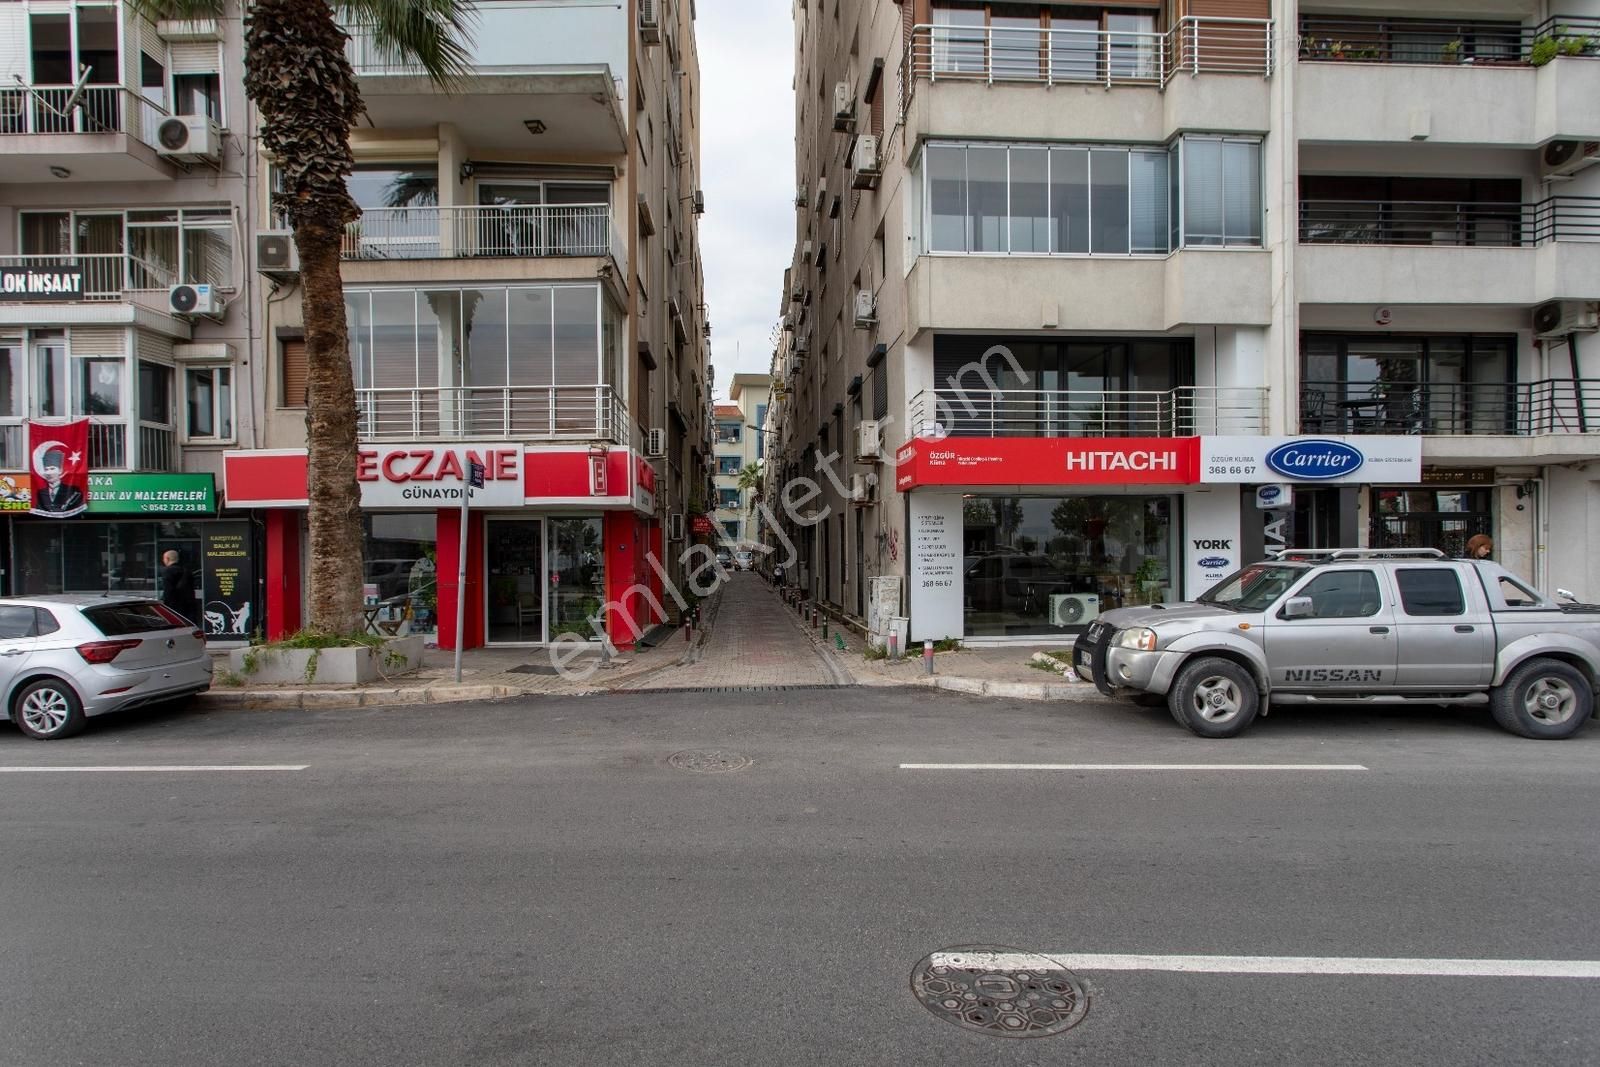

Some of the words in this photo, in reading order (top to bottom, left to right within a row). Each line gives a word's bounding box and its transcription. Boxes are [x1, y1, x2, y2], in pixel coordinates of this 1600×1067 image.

[27, 270, 81, 295] İNŞAAT
[929, 450, 956, 460] ÖZGÜR
[1067, 451, 1177, 471] HITACHI
[1283, 450, 1351, 467] Carrier
[357, 449, 518, 484] ECZANE
[1208, 466, 1227, 474] 368
[1229, 466, 1242, 474] 66
[1244, 466, 1256, 474] 67
[118, 491, 132, 500] AV
[134, 487, 207, 500] MALZEMELERİ
[1193, 540, 1231, 549] YORK
[1284, 669, 1382, 682] NISSAN
